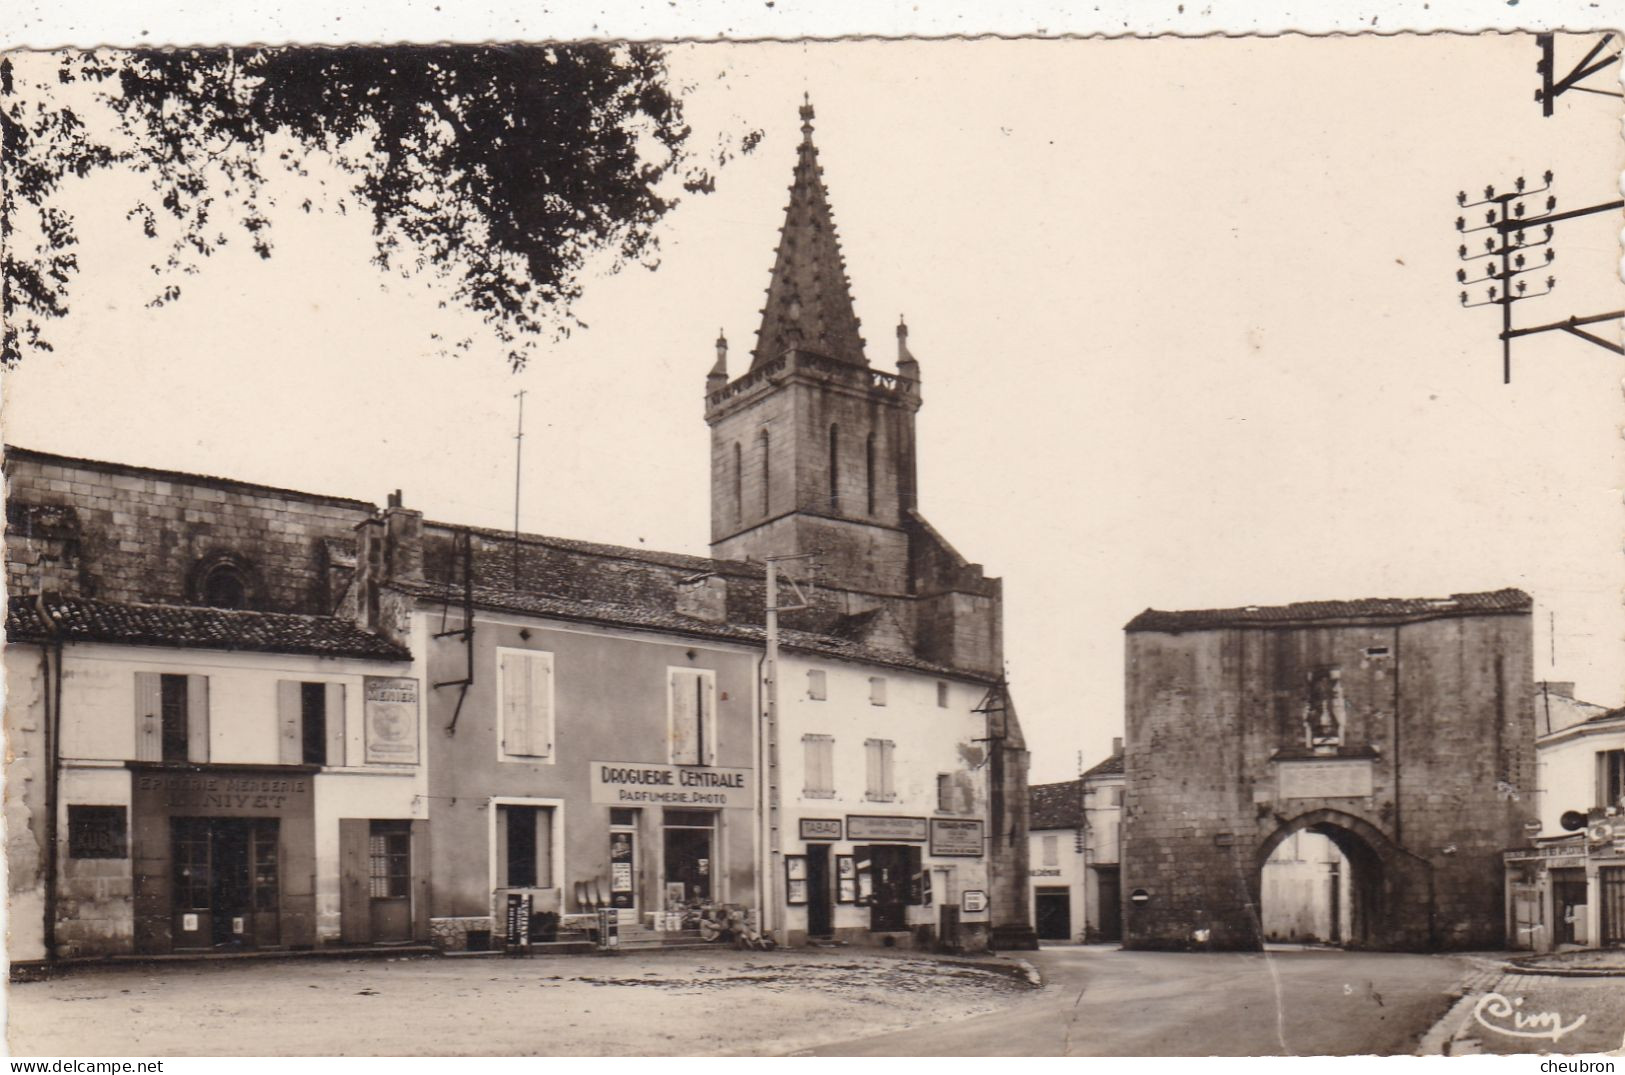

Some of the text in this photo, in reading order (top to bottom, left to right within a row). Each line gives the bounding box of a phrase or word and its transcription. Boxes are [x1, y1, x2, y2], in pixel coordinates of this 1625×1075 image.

[601, 766, 744, 788] DROGUERIE CENTRALE
[226, 779, 305, 793] MERCERIE
[201, 794, 287, 809] NIVET
[804, 822, 837, 834] TABAC
